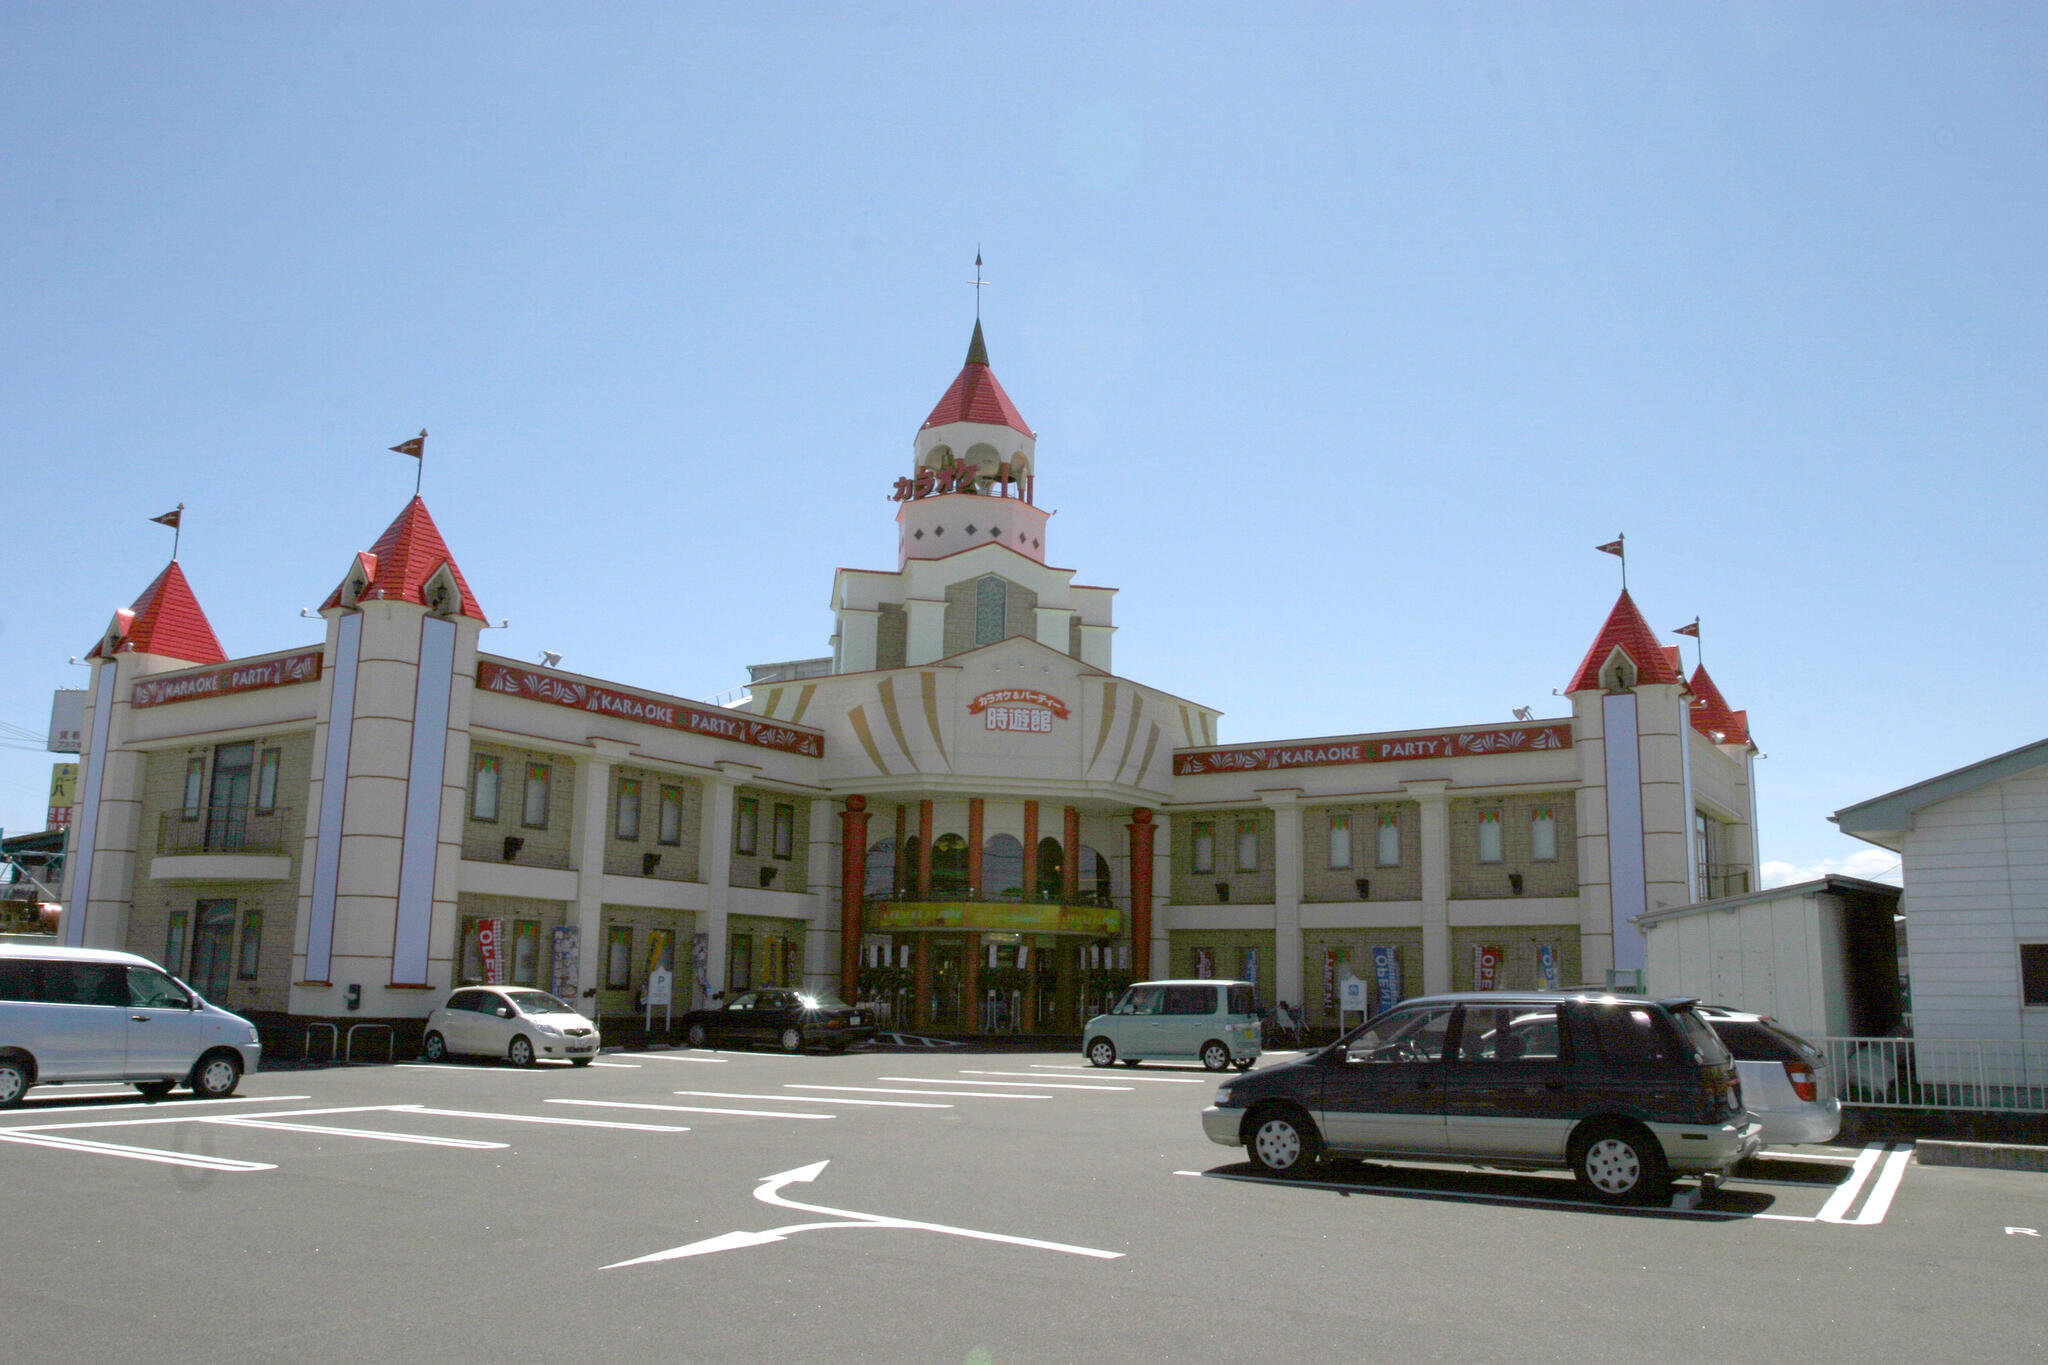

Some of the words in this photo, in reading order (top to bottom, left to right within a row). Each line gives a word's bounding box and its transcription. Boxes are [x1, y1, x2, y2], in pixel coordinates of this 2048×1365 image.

[893, 458, 978, 502] カラオケ
[166, 675, 219, 697] KARAOKE
[232, 666, 272, 688] PARTY
[601, 694, 673, 723] KARAOKE
[691, 713, 736, 735] PARTY
[986, 706, 1052, 732] 時遊館
[1282, 746, 1360, 764] KARAOKE
[1365, 745, 1377, 758] &
[1382, 741, 1438, 757] PARTY
[657, 975, 665, 985] P
